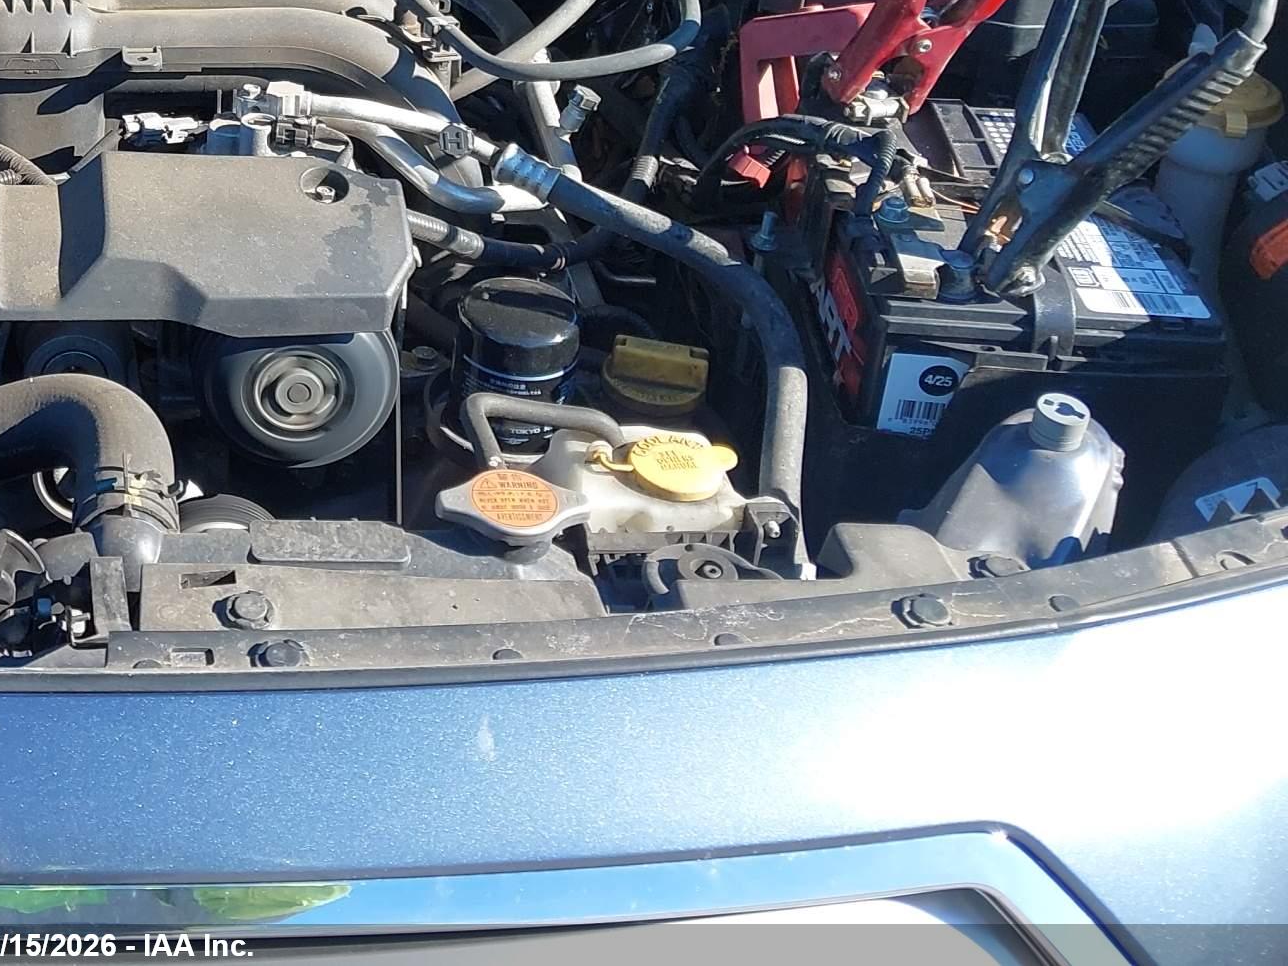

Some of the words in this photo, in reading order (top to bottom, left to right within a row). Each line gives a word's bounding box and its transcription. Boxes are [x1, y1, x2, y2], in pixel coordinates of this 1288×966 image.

[923, 375, 953, 387] 4/25
[510, 427, 541, 435] TOKYO
[498, 481, 538, 489] WARNING
